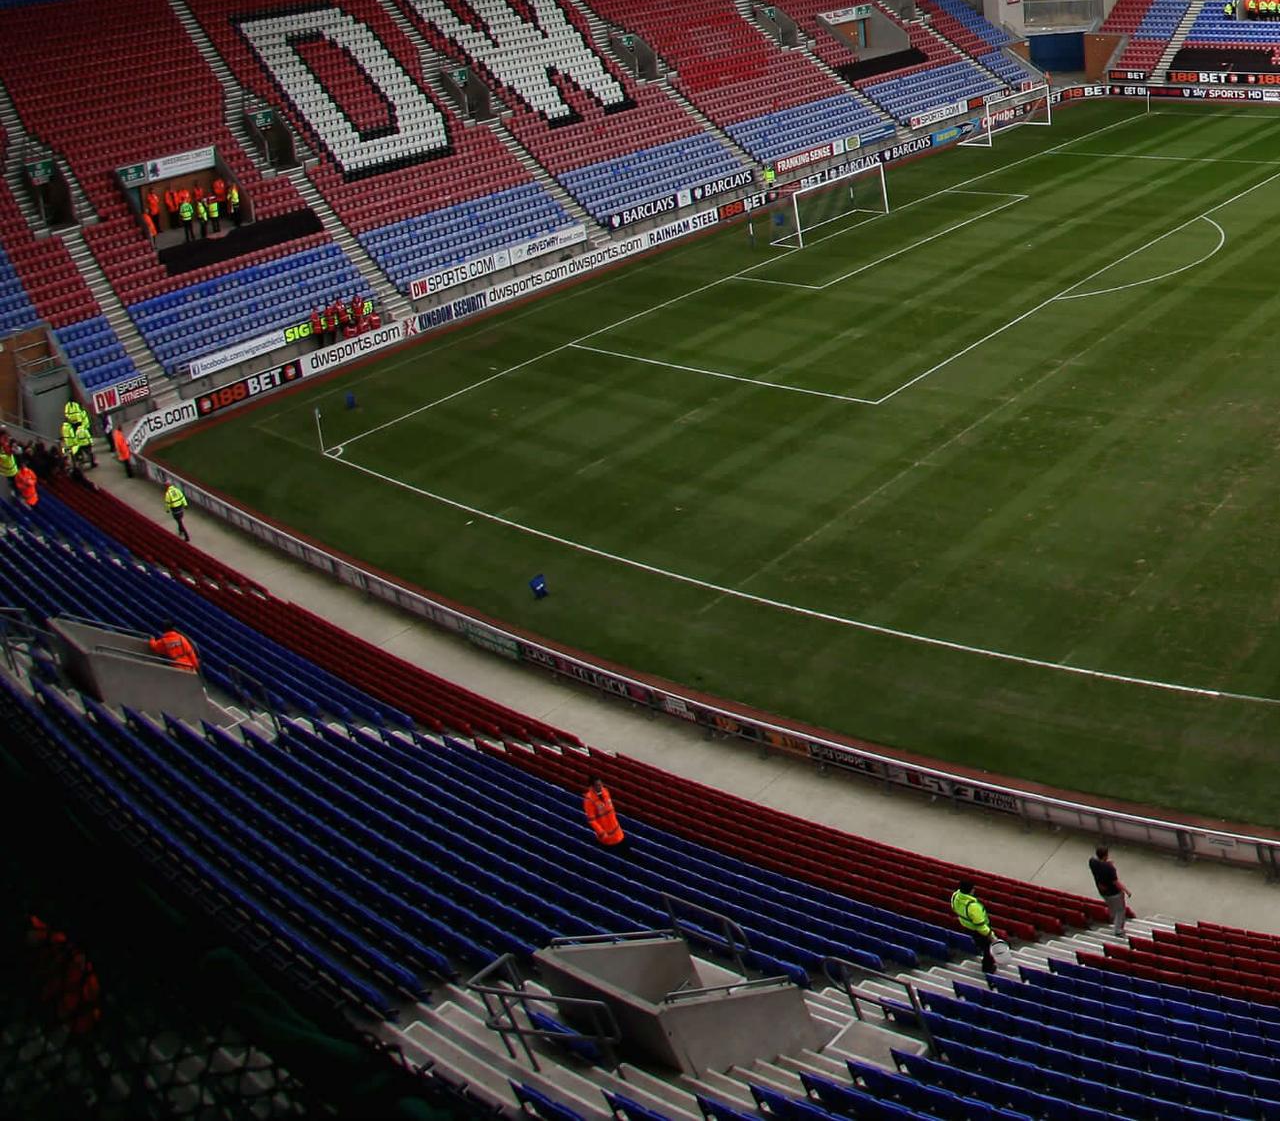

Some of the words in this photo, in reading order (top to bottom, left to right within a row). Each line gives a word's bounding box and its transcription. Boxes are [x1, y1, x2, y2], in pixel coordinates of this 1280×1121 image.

[1170, 72, 1227, 83] 188BET
[1193, 88, 1206, 98] sky
[1209, 89, 1245, 98] SPORTS
[1248, 91, 1262, 99] HD
[893, 136, 931, 161] BARCLAYS
[705, 171, 752, 198] BARCLAYS
[623, 196, 675, 225] BARCLAYS
[649, 217, 690, 245] RAINHAM
[692, 209, 717, 229] STEEL
[569, 237, 642, 275] dwsports.com
[489, 264, 567, 302] dwsports.com
[418, 305, 453, 331] KINGDOM
[453, 292, 488, 319] SECURITY
[310, 326, 401, 370] dwsports.com
[96, 388, 118, 412] DW
[118, 376, 148, 394] SPORTS
[120, 386, 150, 405] FITNESS
[212, 368, 282, 411] 188BET
